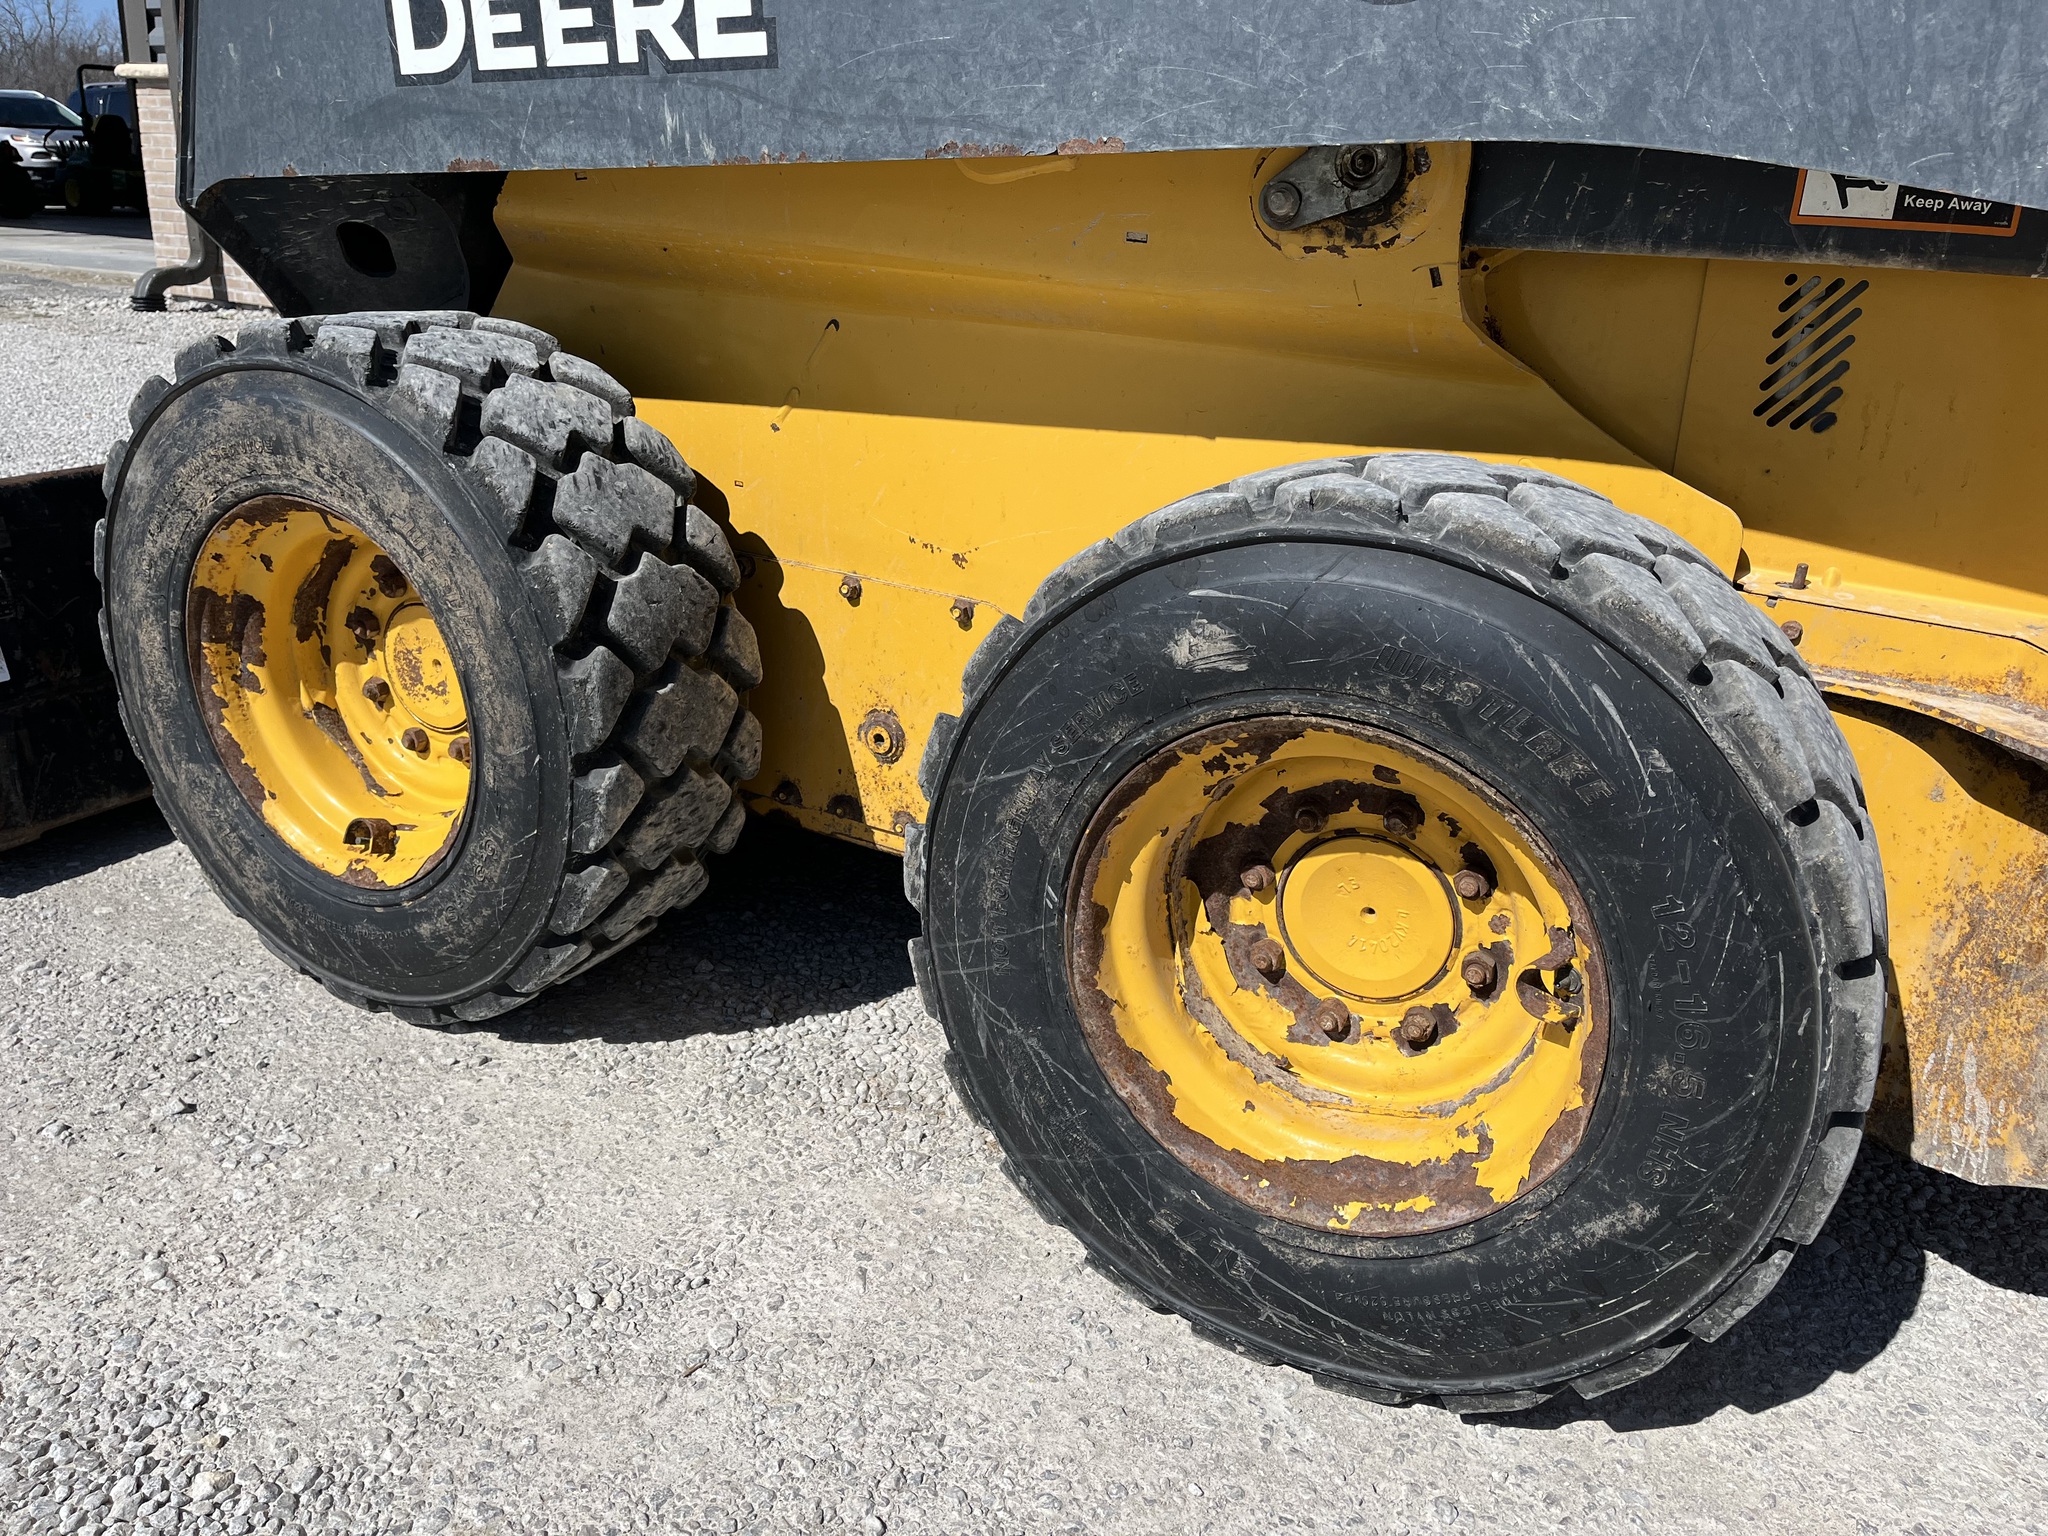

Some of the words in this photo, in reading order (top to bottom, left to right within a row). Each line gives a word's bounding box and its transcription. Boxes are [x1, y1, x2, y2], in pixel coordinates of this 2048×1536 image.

[391, 0, 768, 75] DEERE
[1903, 194, 1944, 212] Keep
[1949, 197, 1993, 215] Away
[1050, 672, 1146, 757] SERVICE
[1371, 643, 1618, 806] WESTLAKE
[1650, 894, 1711, 1100] 12-16.5
[1637, 1110, 1690, 1187] NHS
[1381, 1309, 1437, 1323] NYLON
[1391, 1290, 1472, 1308] PRESSURE
[1440, 1294, 1523, 1319] TUBELESS
